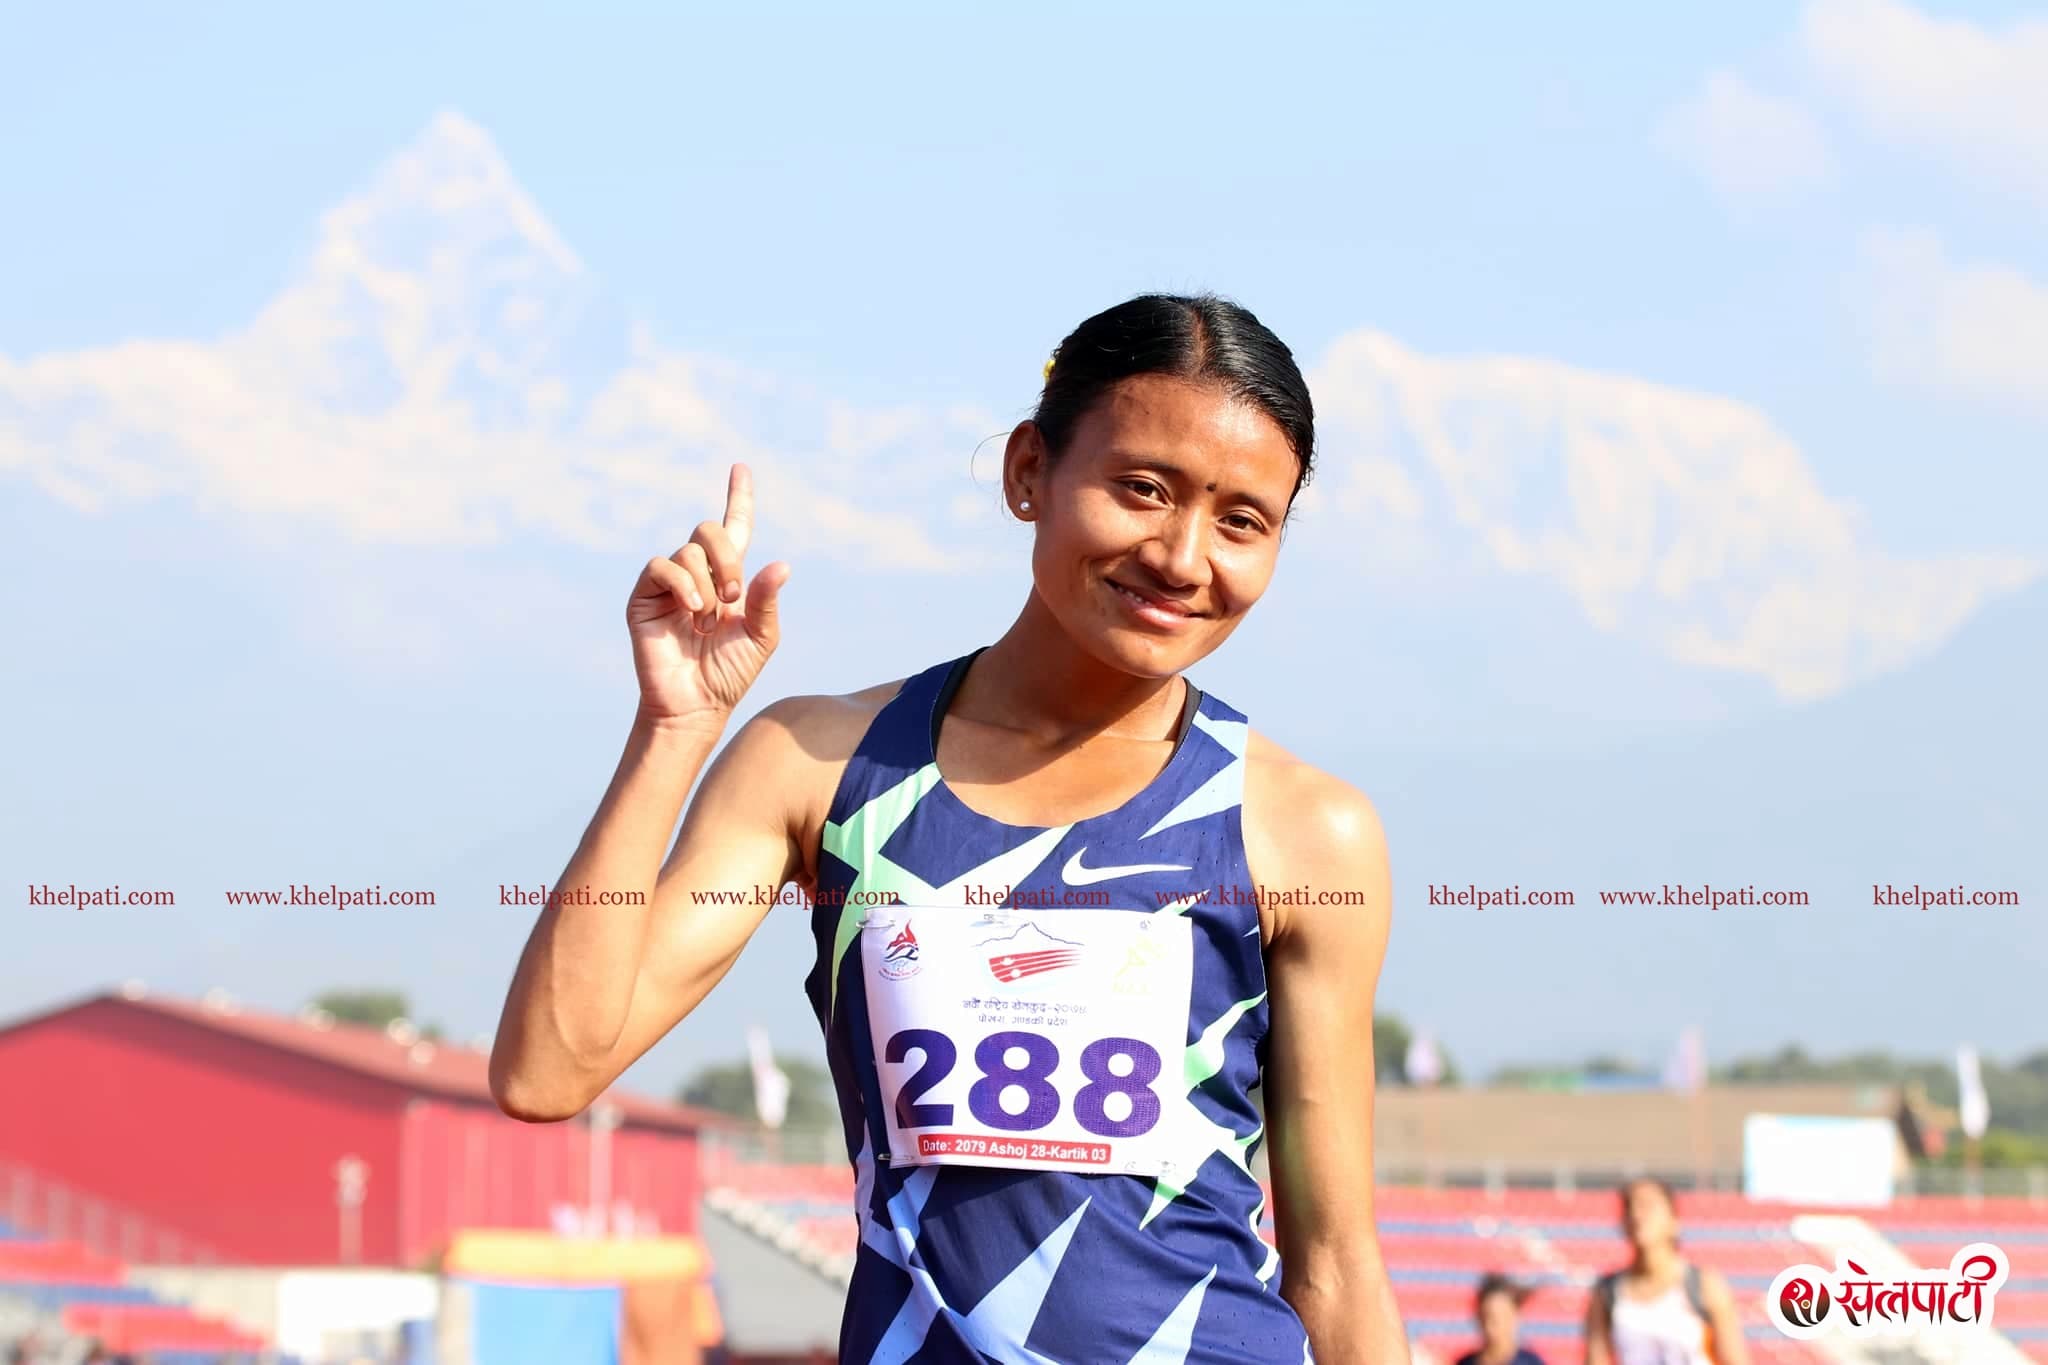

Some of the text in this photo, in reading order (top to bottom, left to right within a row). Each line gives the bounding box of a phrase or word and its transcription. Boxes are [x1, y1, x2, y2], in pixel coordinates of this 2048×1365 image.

[885, 1029, 1162, 1138] 288
[923, 1139, 1106, 1162] Date: 2079 Ashoj 28-Kartik 03
